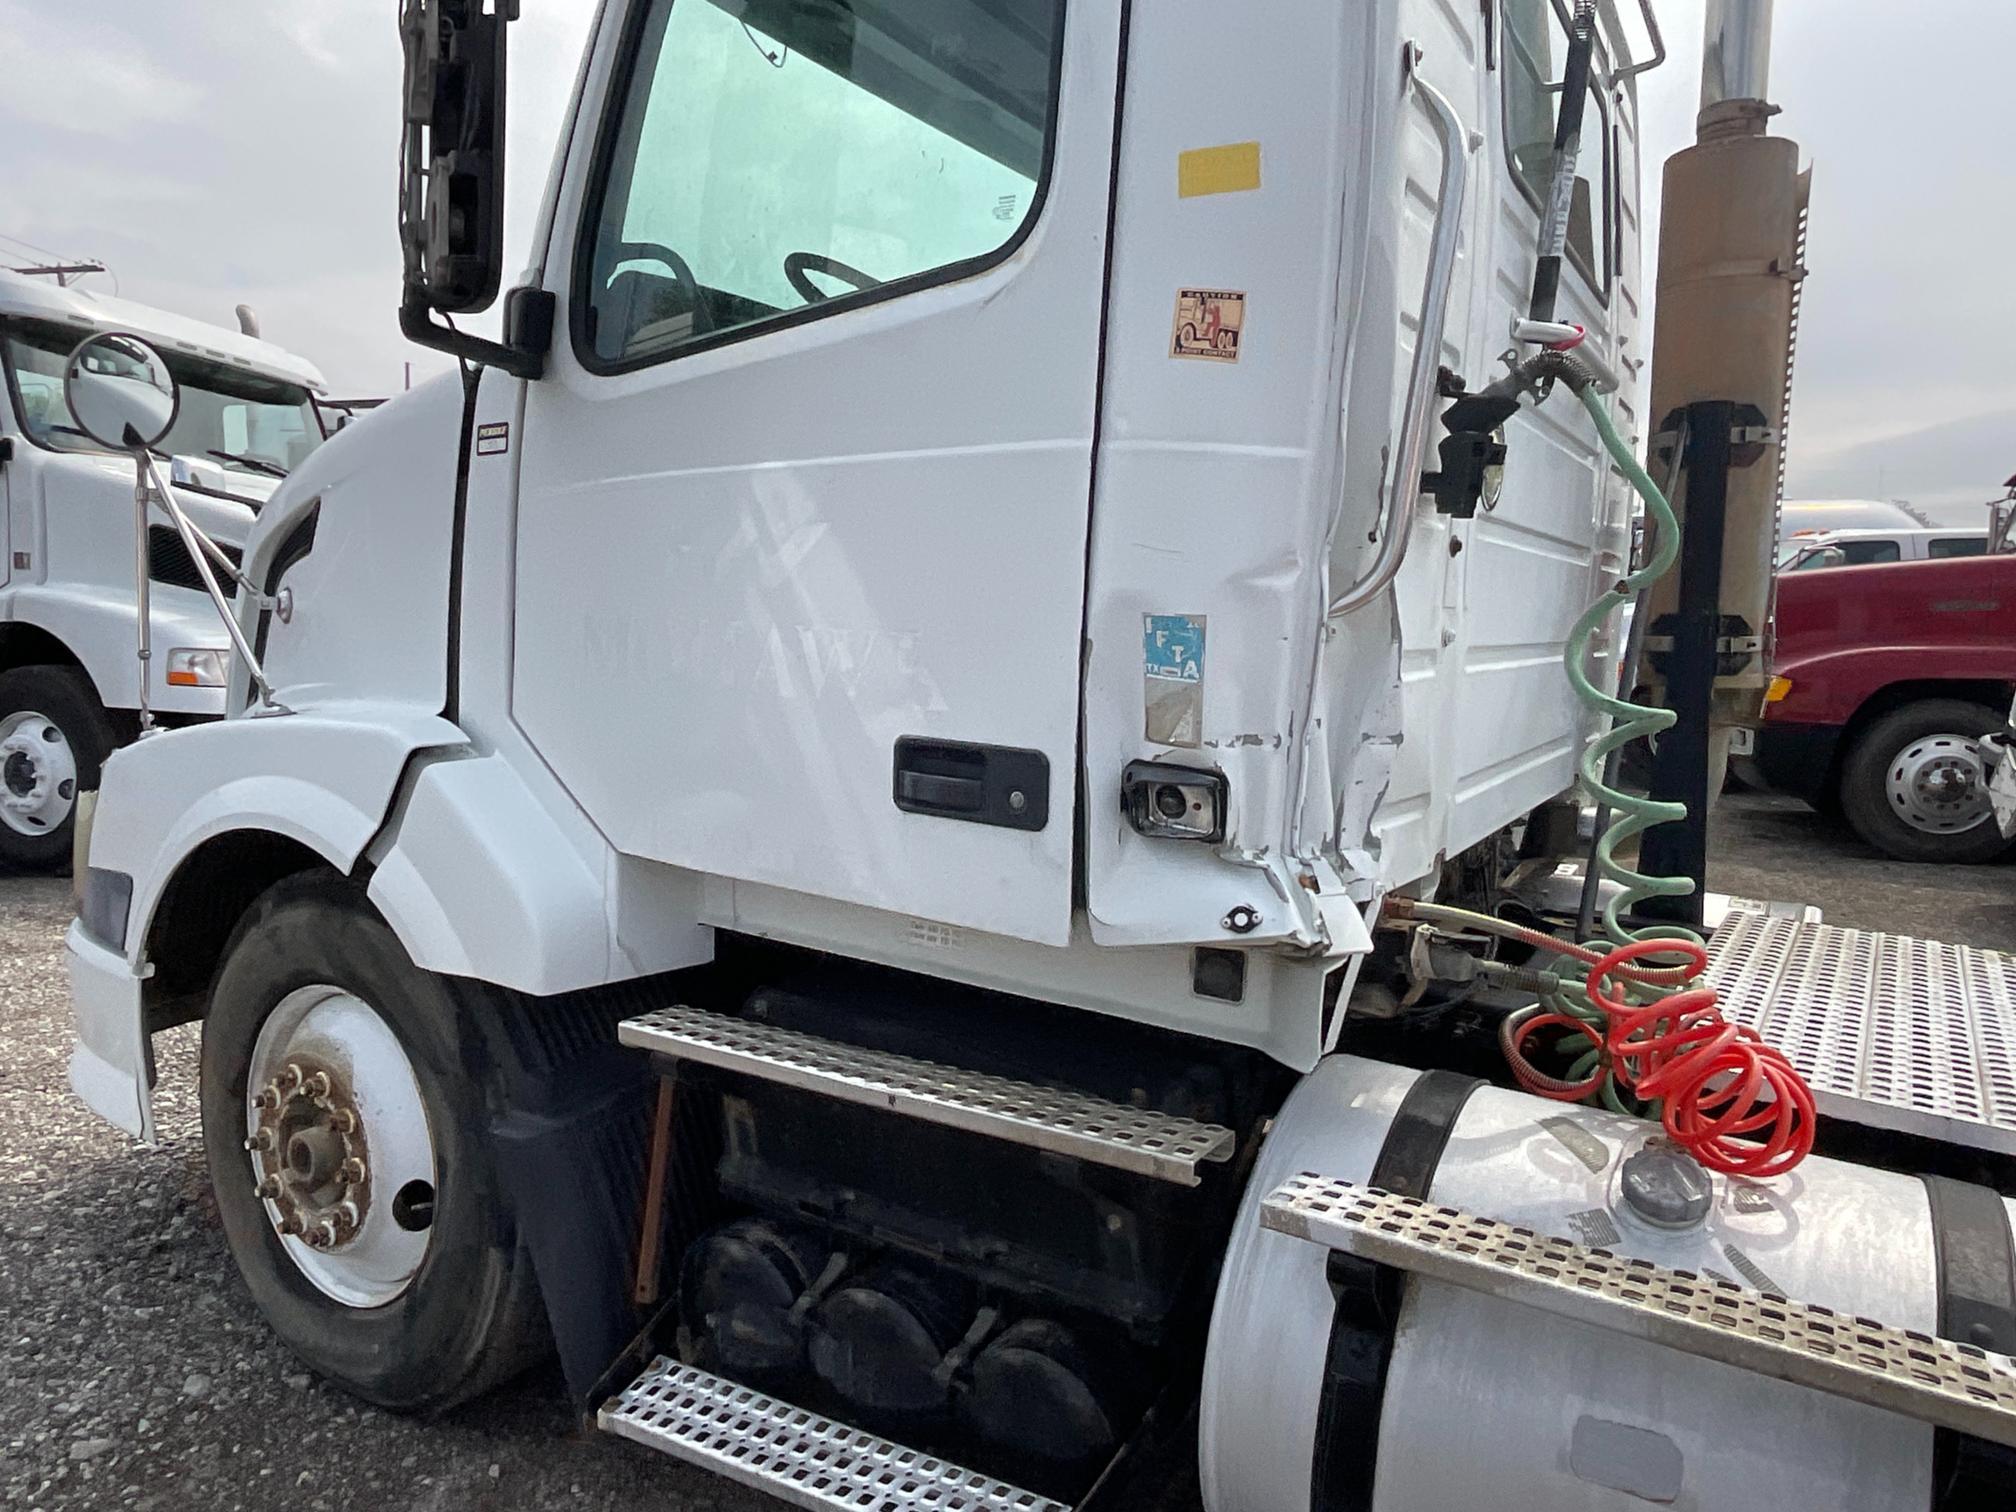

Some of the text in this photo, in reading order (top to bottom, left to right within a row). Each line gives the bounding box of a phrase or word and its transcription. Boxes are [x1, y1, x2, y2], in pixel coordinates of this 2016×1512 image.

[1187, 291, 1237, 300] CAUTION
[1203, 349, 1235, 359] CONTACT
[1146, 663, 1160, 674] TX
